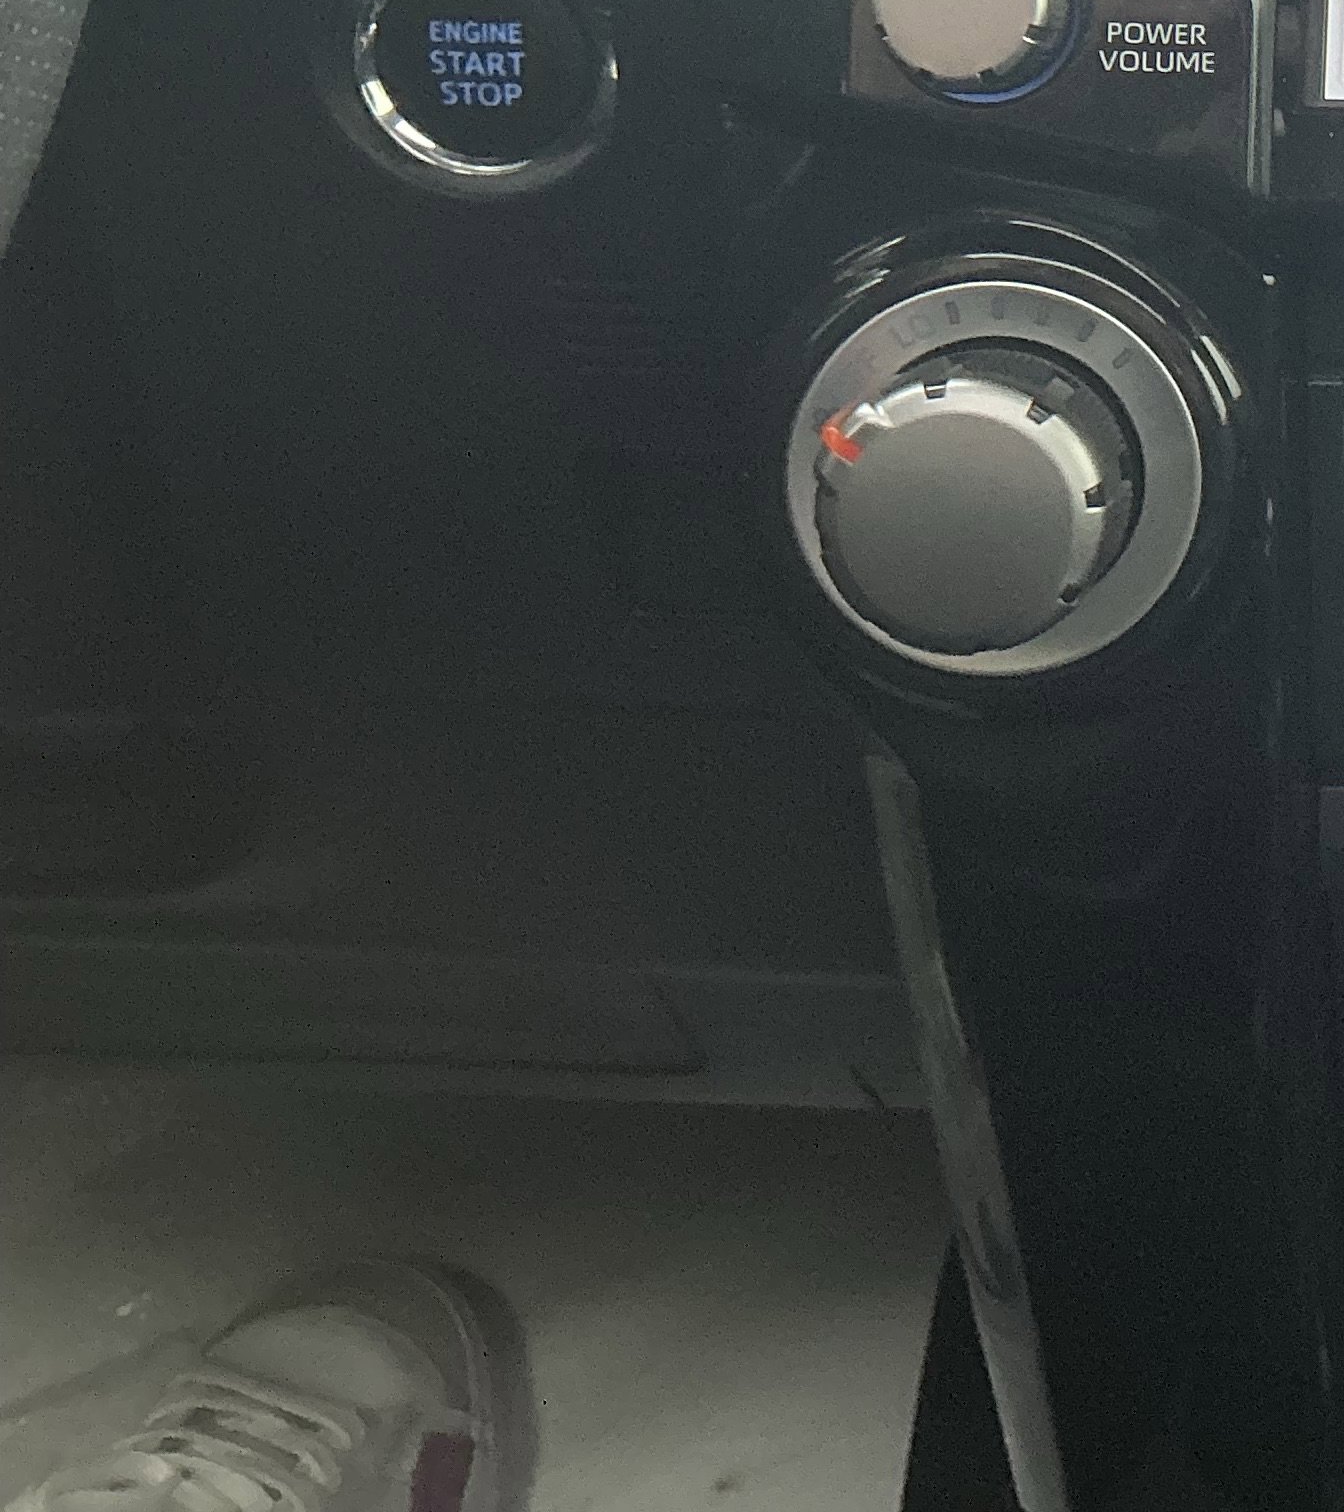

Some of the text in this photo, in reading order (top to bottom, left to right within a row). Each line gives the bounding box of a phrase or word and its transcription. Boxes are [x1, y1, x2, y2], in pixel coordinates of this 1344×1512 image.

[428, 19, 524, 45] ENGINE
[1107, 21, 1207, 46] POWER
[428, 50, 526, 77] START
[1098, 49, 1216, 74] VOLUME
[439, 81, 524, 108] STOP
